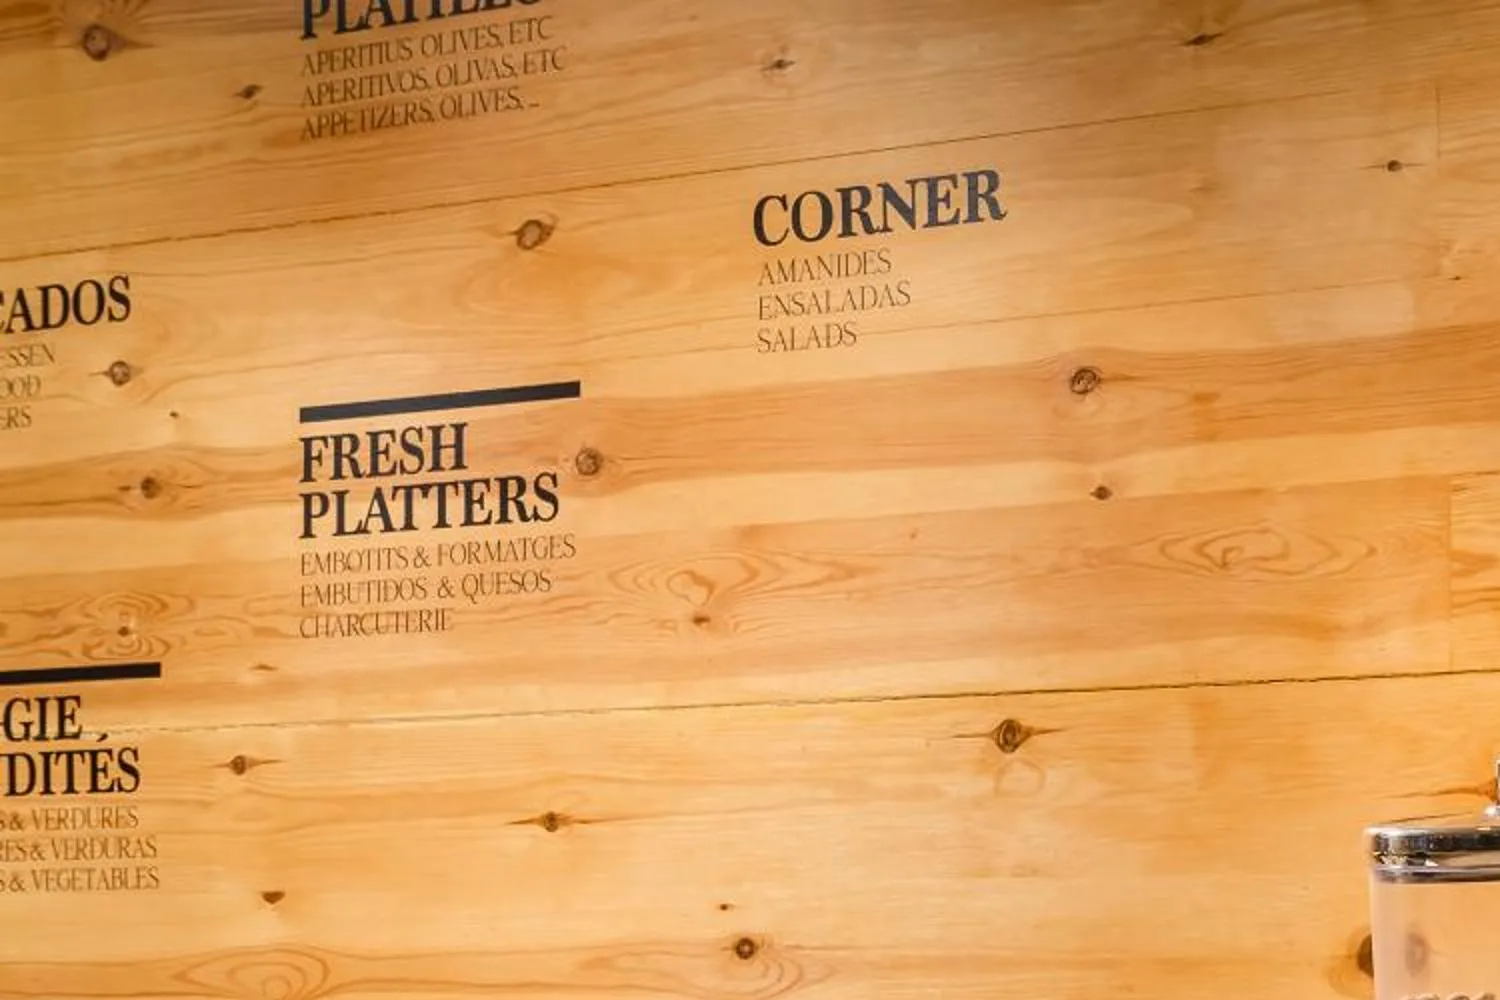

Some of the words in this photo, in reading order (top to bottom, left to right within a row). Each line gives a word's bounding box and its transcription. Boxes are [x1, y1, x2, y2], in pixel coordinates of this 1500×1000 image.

[508, 15, 555, 45] ETC
[522, 46, 567, 75] ETC
[753, 168, 1008, 247] CORNER
[758, 249, 892, 287] AMANIDES
[0, 274, 131, 334] ADOS
[758, 281, 912, 321] ENSALADAS
[757, 322, 857, 353] SALADS
[298, 422, 469, 484] FRESH
[298, 471, 560, 539] PLATTERS
[301, 546, 409, 577] EMBOTITS
[413, 545, 432, 569] &
[437, 533, 577, 567] FORMATGES
[301, 576, 428, 607] EMBUTIDOS
[437, 575, 456, 599] &
[462, 569, 552, 604] QUESOS
[300, 607, 455, 639] CHARCUTERIE
[0, 696, 83, 742] GIE
[0, 733, 141, 796] DITÉS
[9, 811, 25, 831] &
[31, 805, 139, 831] VERDURES
[0, 839, 27, 862] ES
[30, 842, 46, 861] &
[51, 835, 158, 860] VERDURAS
[8, 874, 25, 893] &
[31, 866, 160, 893] VEGETABLES
